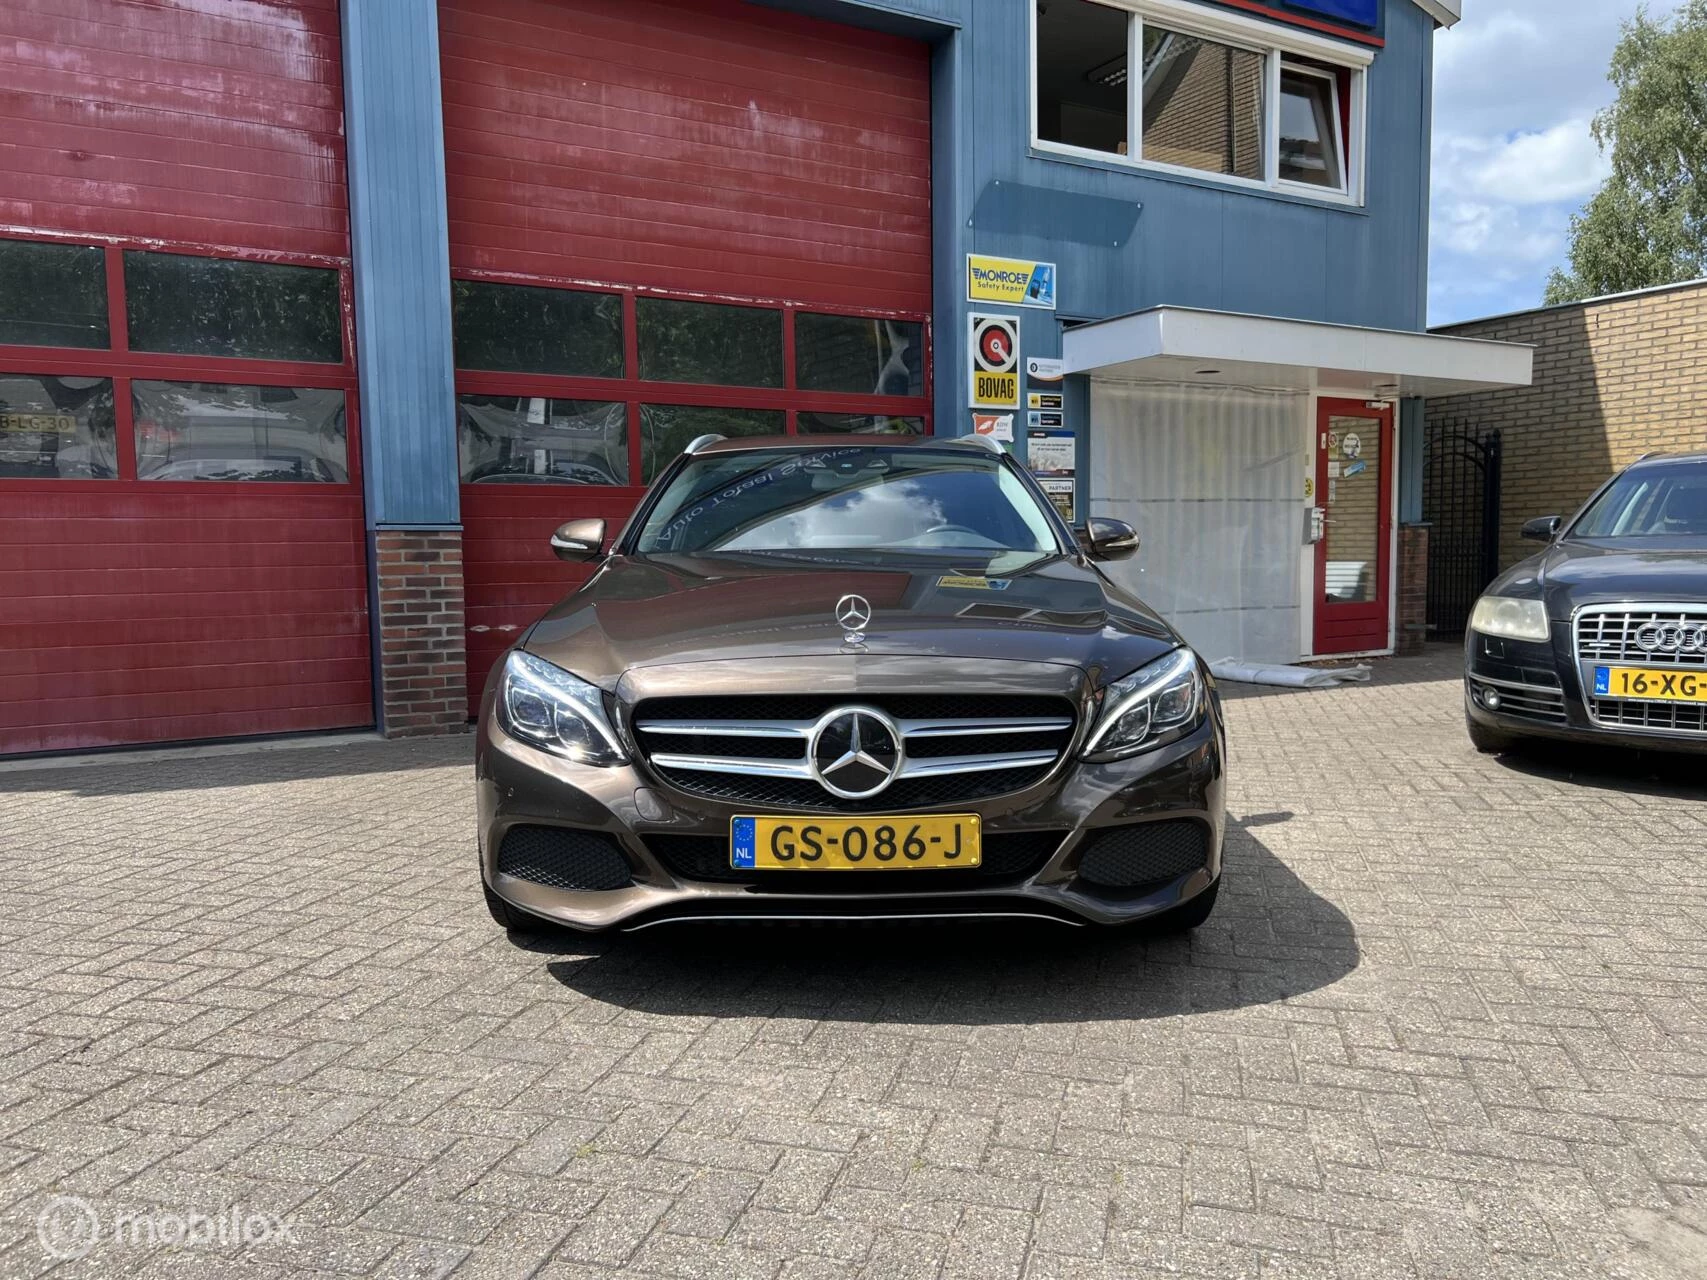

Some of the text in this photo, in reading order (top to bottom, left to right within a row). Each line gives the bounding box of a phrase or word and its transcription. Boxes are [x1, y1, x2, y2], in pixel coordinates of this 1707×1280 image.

[976, 269, 1026, 284] MONROE
[977, 281, 1024, 293] Safety Expert
[978, 377, 1014, 399] BOVAG
[1596, 683, 1607, 691] NL
[770, 823, 962, 862] GS-086-J
[735, 848, 752, 859] NL
